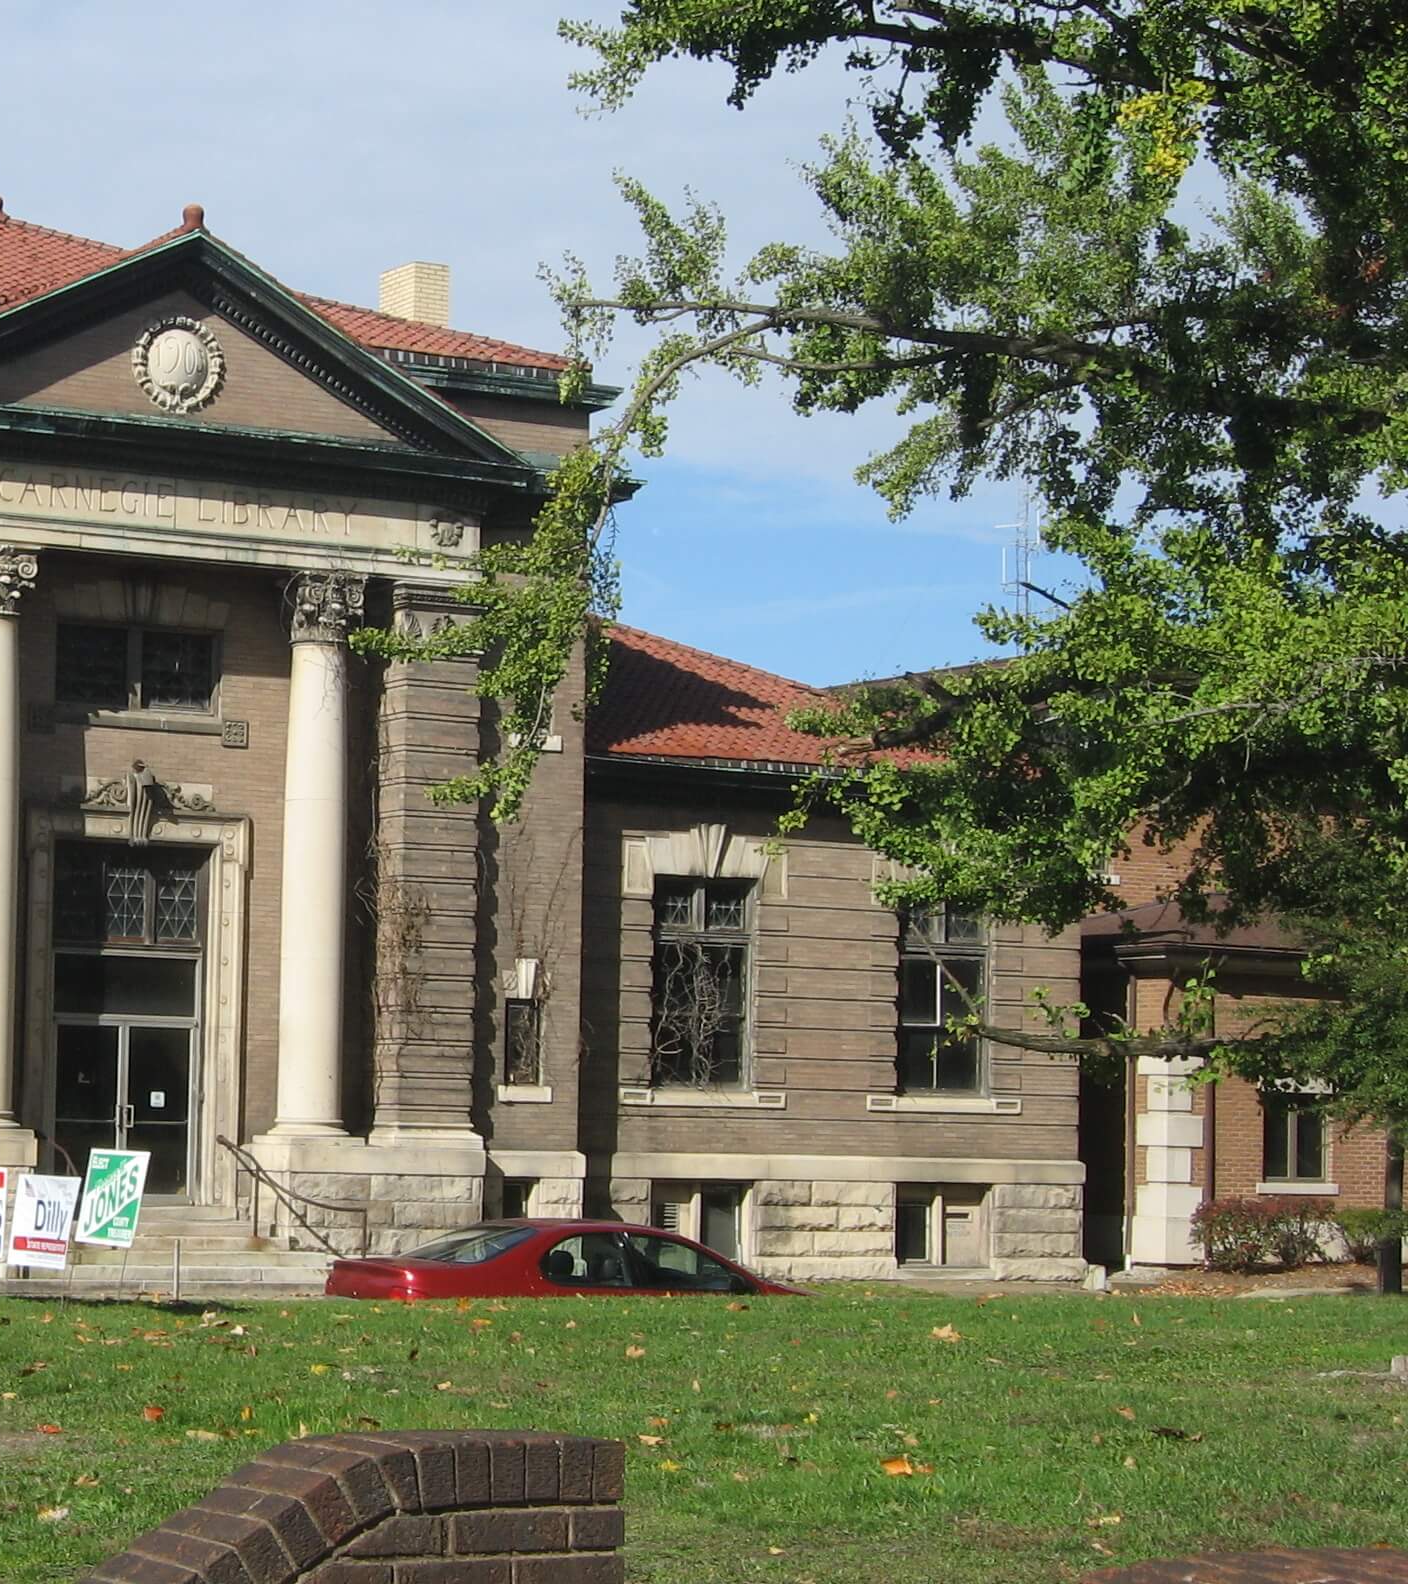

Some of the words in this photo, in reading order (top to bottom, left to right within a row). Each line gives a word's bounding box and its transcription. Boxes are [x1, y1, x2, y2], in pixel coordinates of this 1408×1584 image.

[197, 486, 358, 536] LIBRARY
[34, 1199, 69, 1240] Dilly
[83, 1164, 140, 1233] JONES
